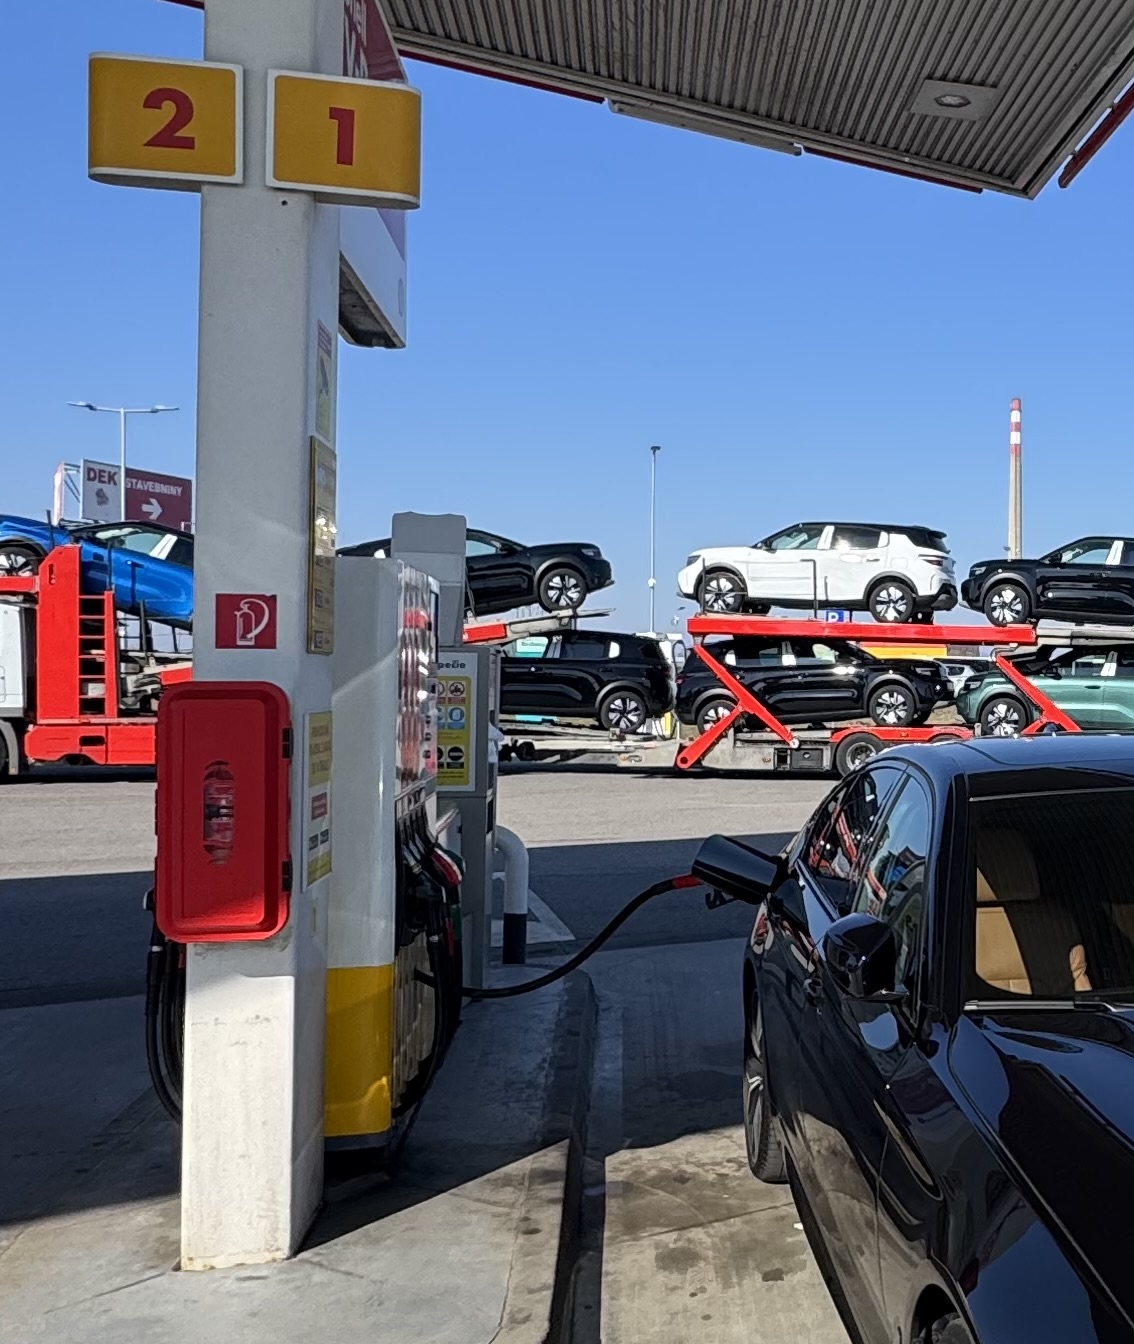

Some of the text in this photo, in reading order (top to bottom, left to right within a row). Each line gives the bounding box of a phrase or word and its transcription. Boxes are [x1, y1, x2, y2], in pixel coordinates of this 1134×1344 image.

[143, 87, 196, 151] 2
[329, 106, 355, 166] 1
[86, 466, 118, 486] DEK
[126, 477, 183, 496] STAVEBNINY
